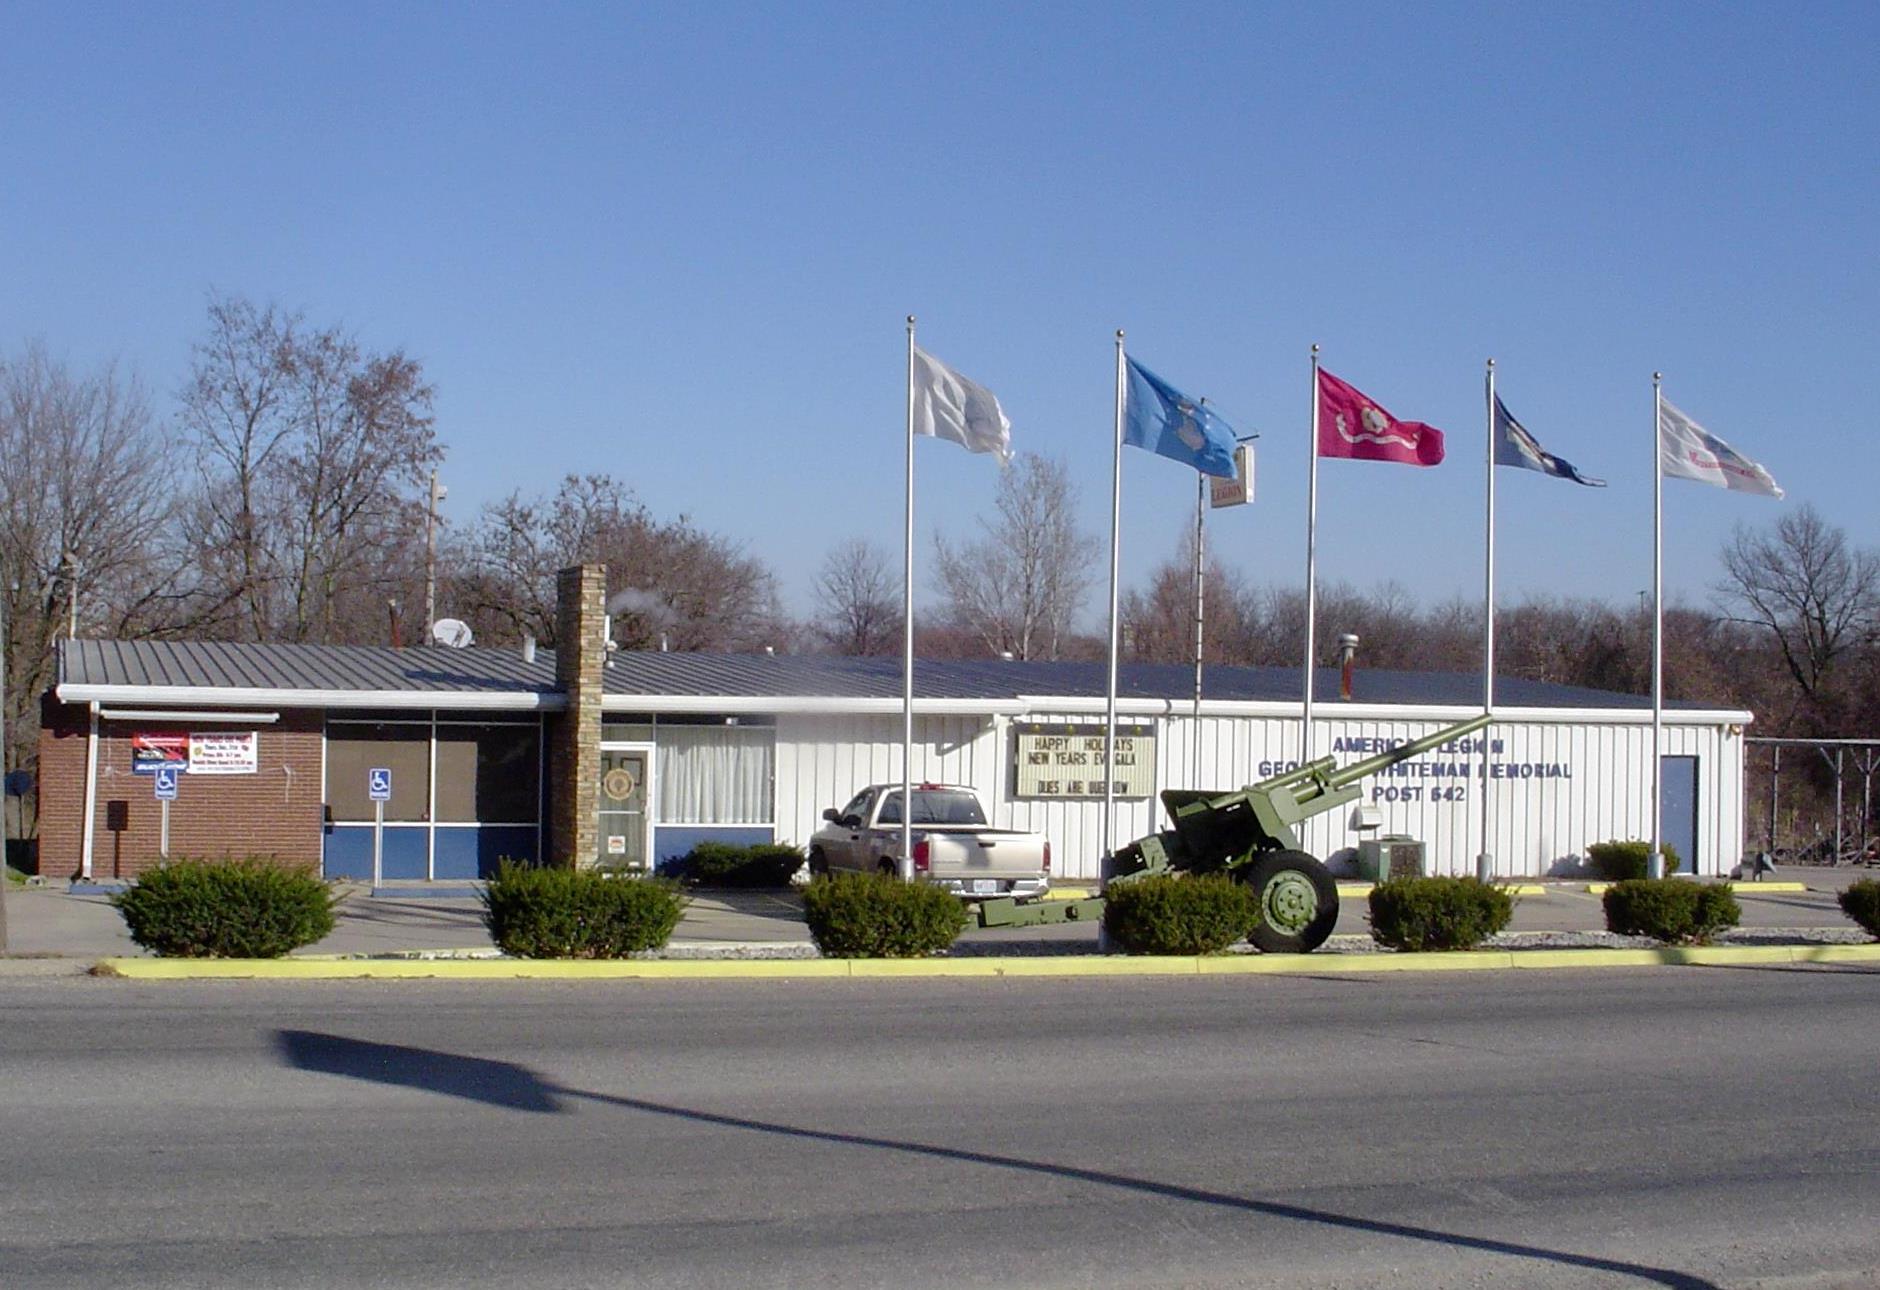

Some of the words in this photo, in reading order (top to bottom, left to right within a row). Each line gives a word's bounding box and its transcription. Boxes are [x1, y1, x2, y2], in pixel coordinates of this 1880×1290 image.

[1034, 737, 1069, 750] HAPPY
[1084, 738, 1133, 751] HOLAYS
[1332, 736, 1422, 754] AMERIC
[1028, 752, 1049, 765] NEW
[1055, 752, 1087, 765] YEARS
[1094, 752, 1110, 765] EV
[1372, 786, 1423, 802] POST
[1431, 786, 1465, 802] 642
